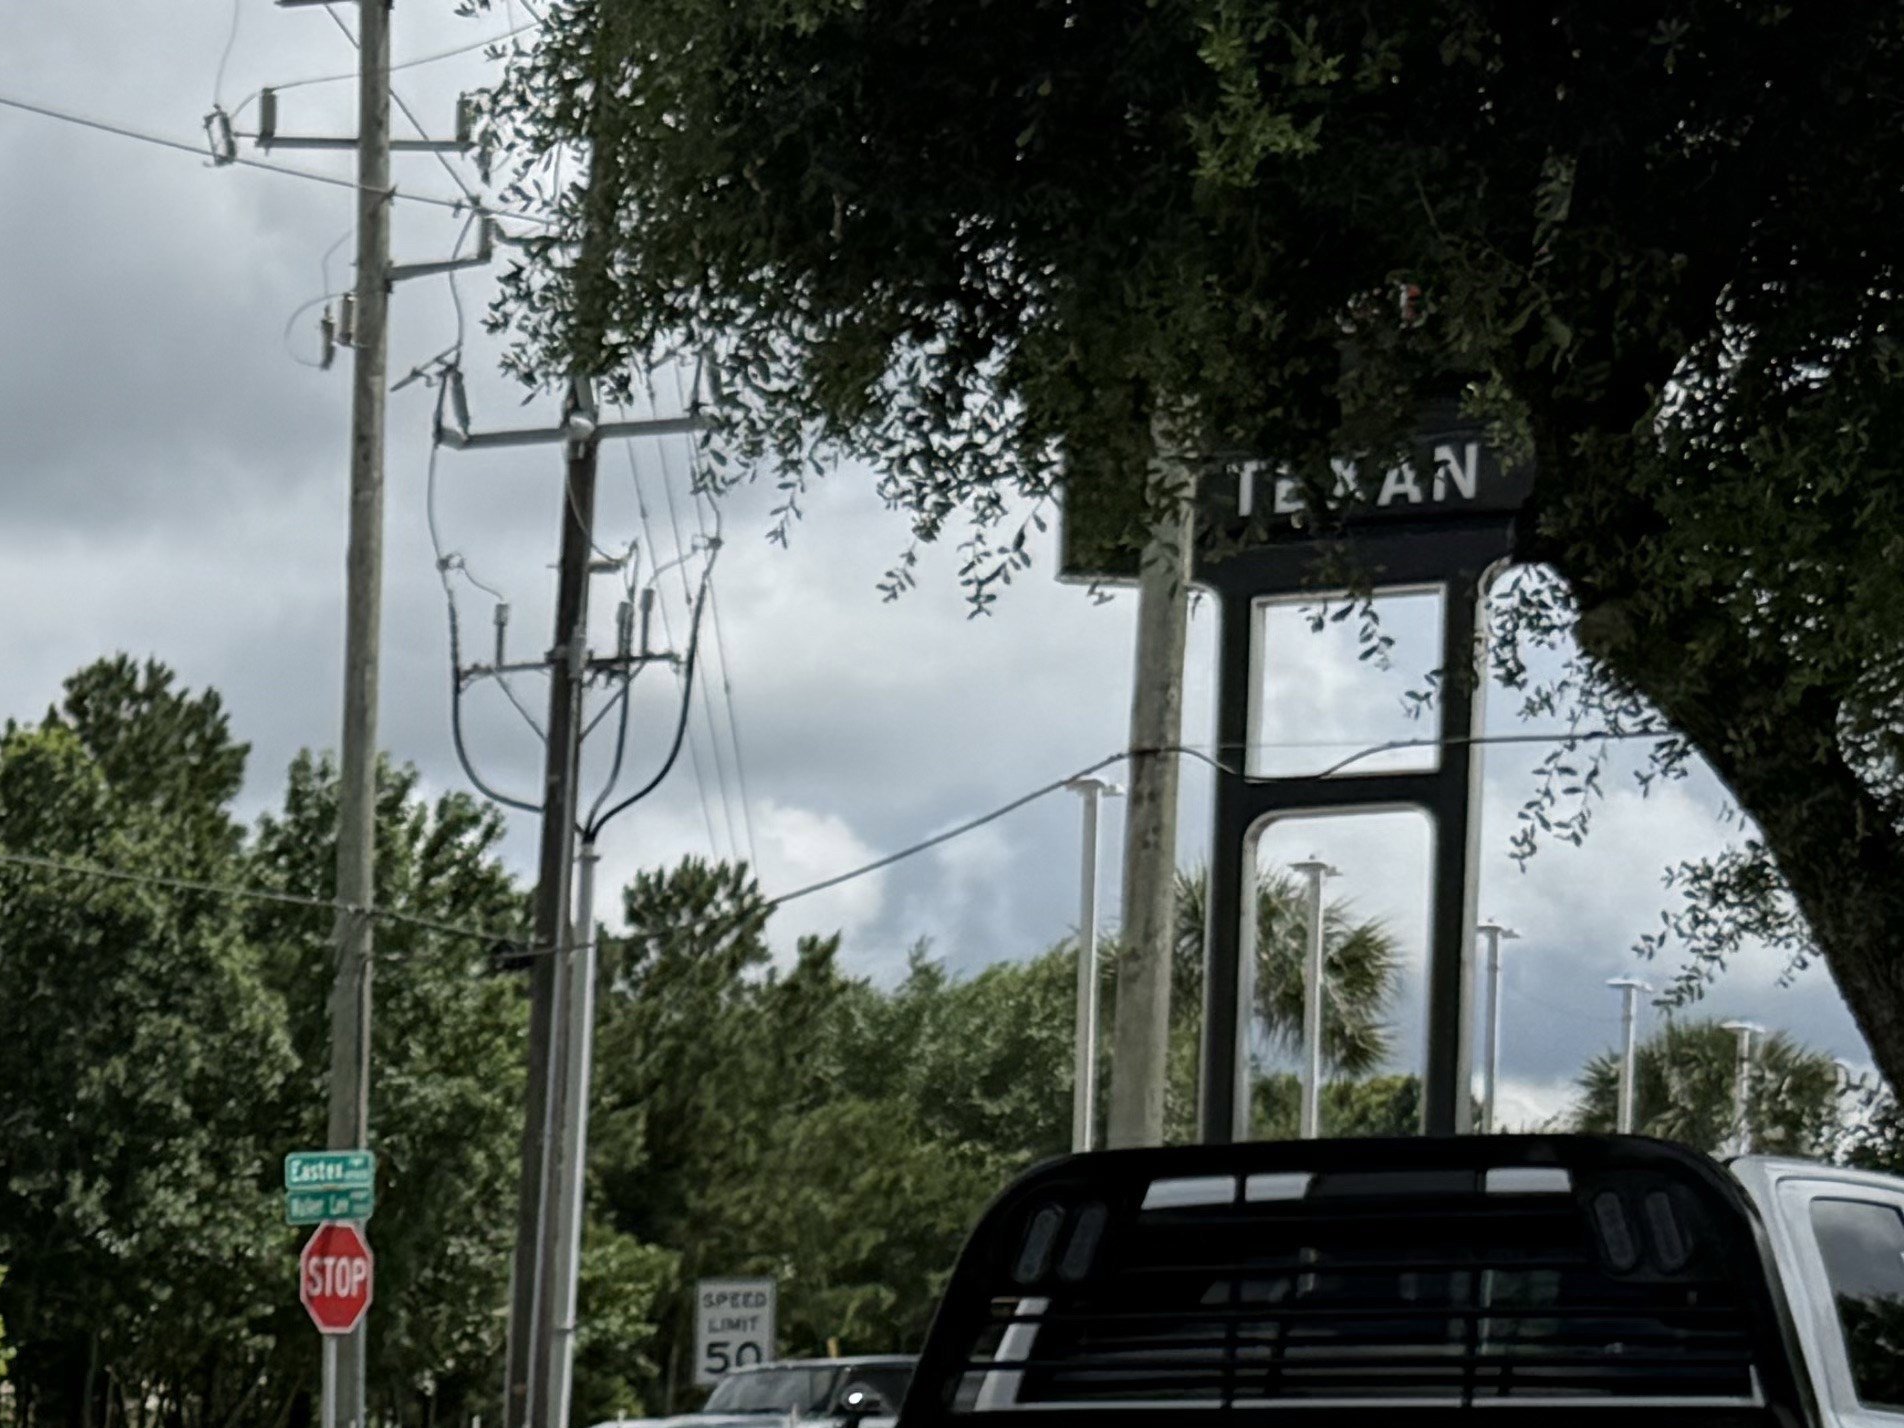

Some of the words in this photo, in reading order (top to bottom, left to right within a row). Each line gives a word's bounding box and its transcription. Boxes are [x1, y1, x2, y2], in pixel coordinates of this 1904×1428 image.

[1226, 443, 1479, 516] TEXAN
[307, 1255, 367, 1298] STOP
[703, 1292, 767, 1309] SPEED
[708, 1315, 760, 1334] LIMIT
[704, 1341, 763, 1374] 50
